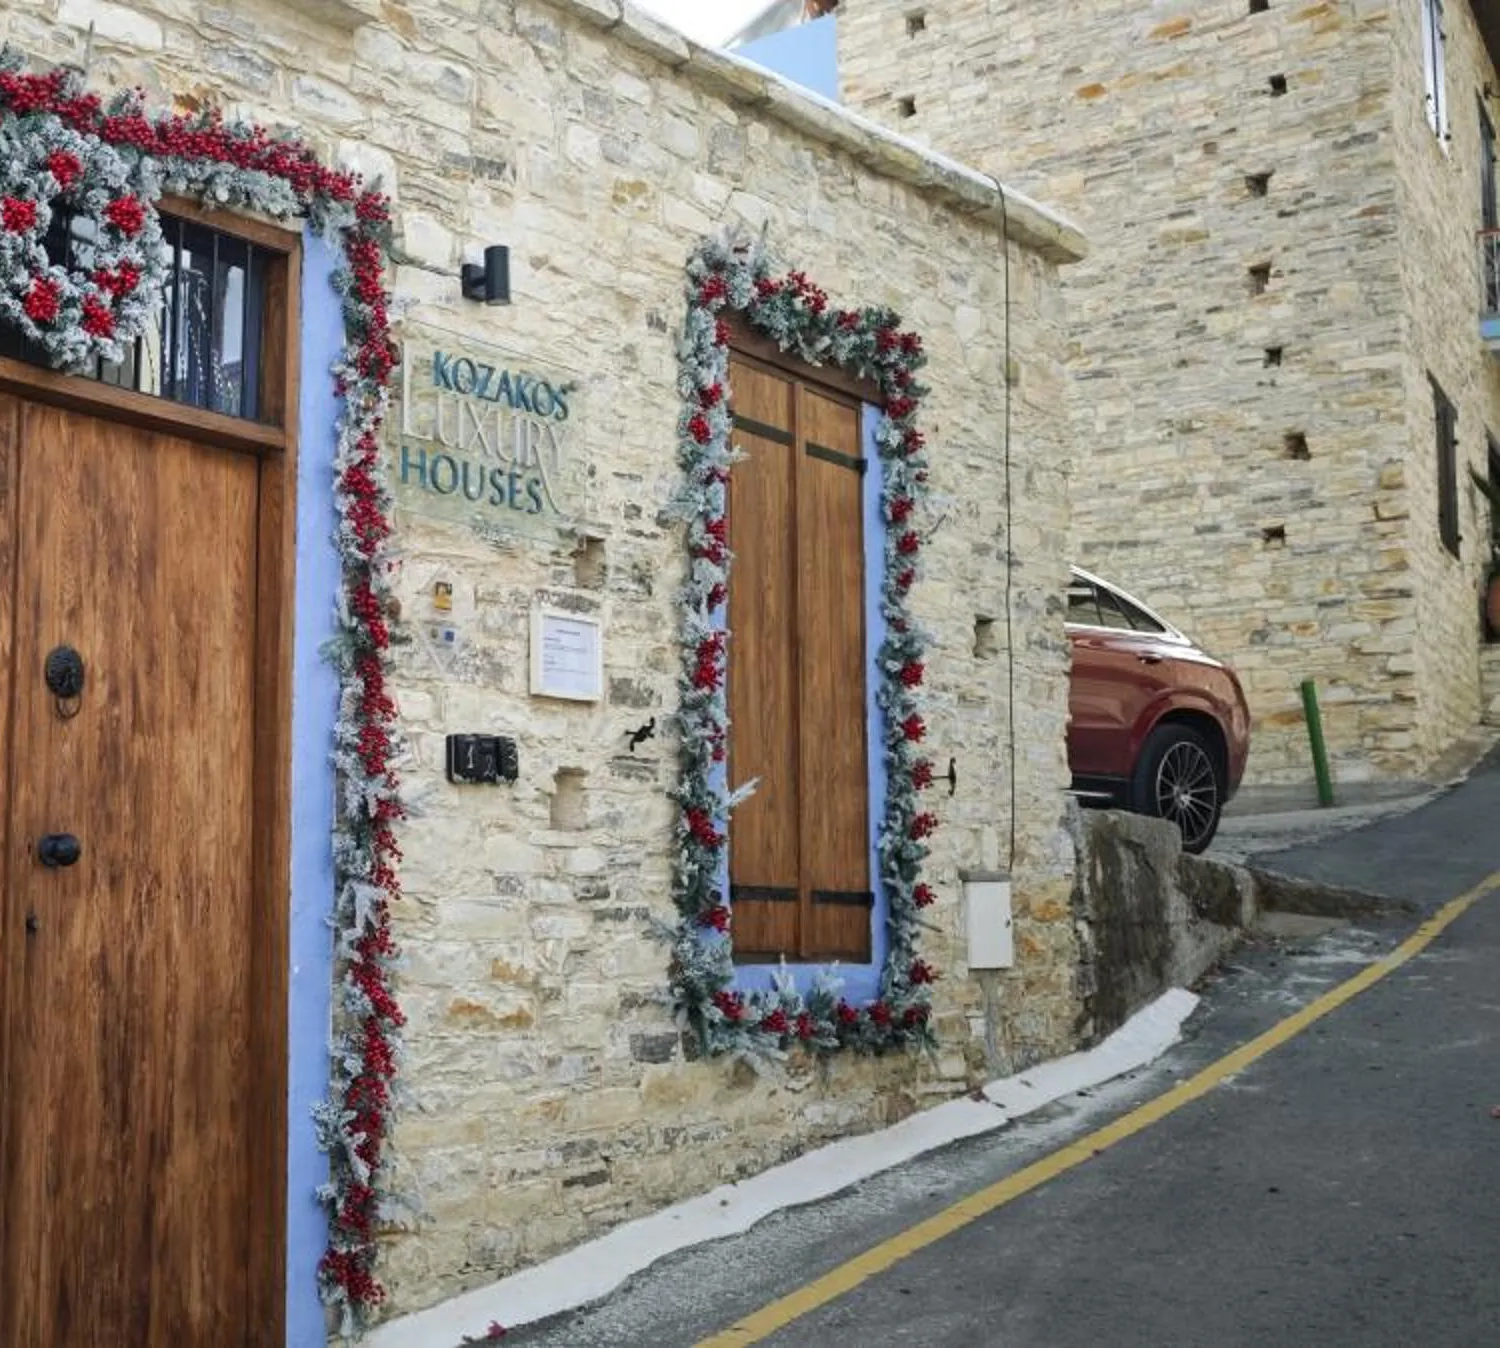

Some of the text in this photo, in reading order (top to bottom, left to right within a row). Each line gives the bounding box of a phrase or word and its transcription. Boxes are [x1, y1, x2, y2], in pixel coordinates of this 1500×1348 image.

[433, 350, 569, 421] KOZAKOS
[402, 340, 573, 520] LUXURY
[401, 445, 543, 514] HOUSES
